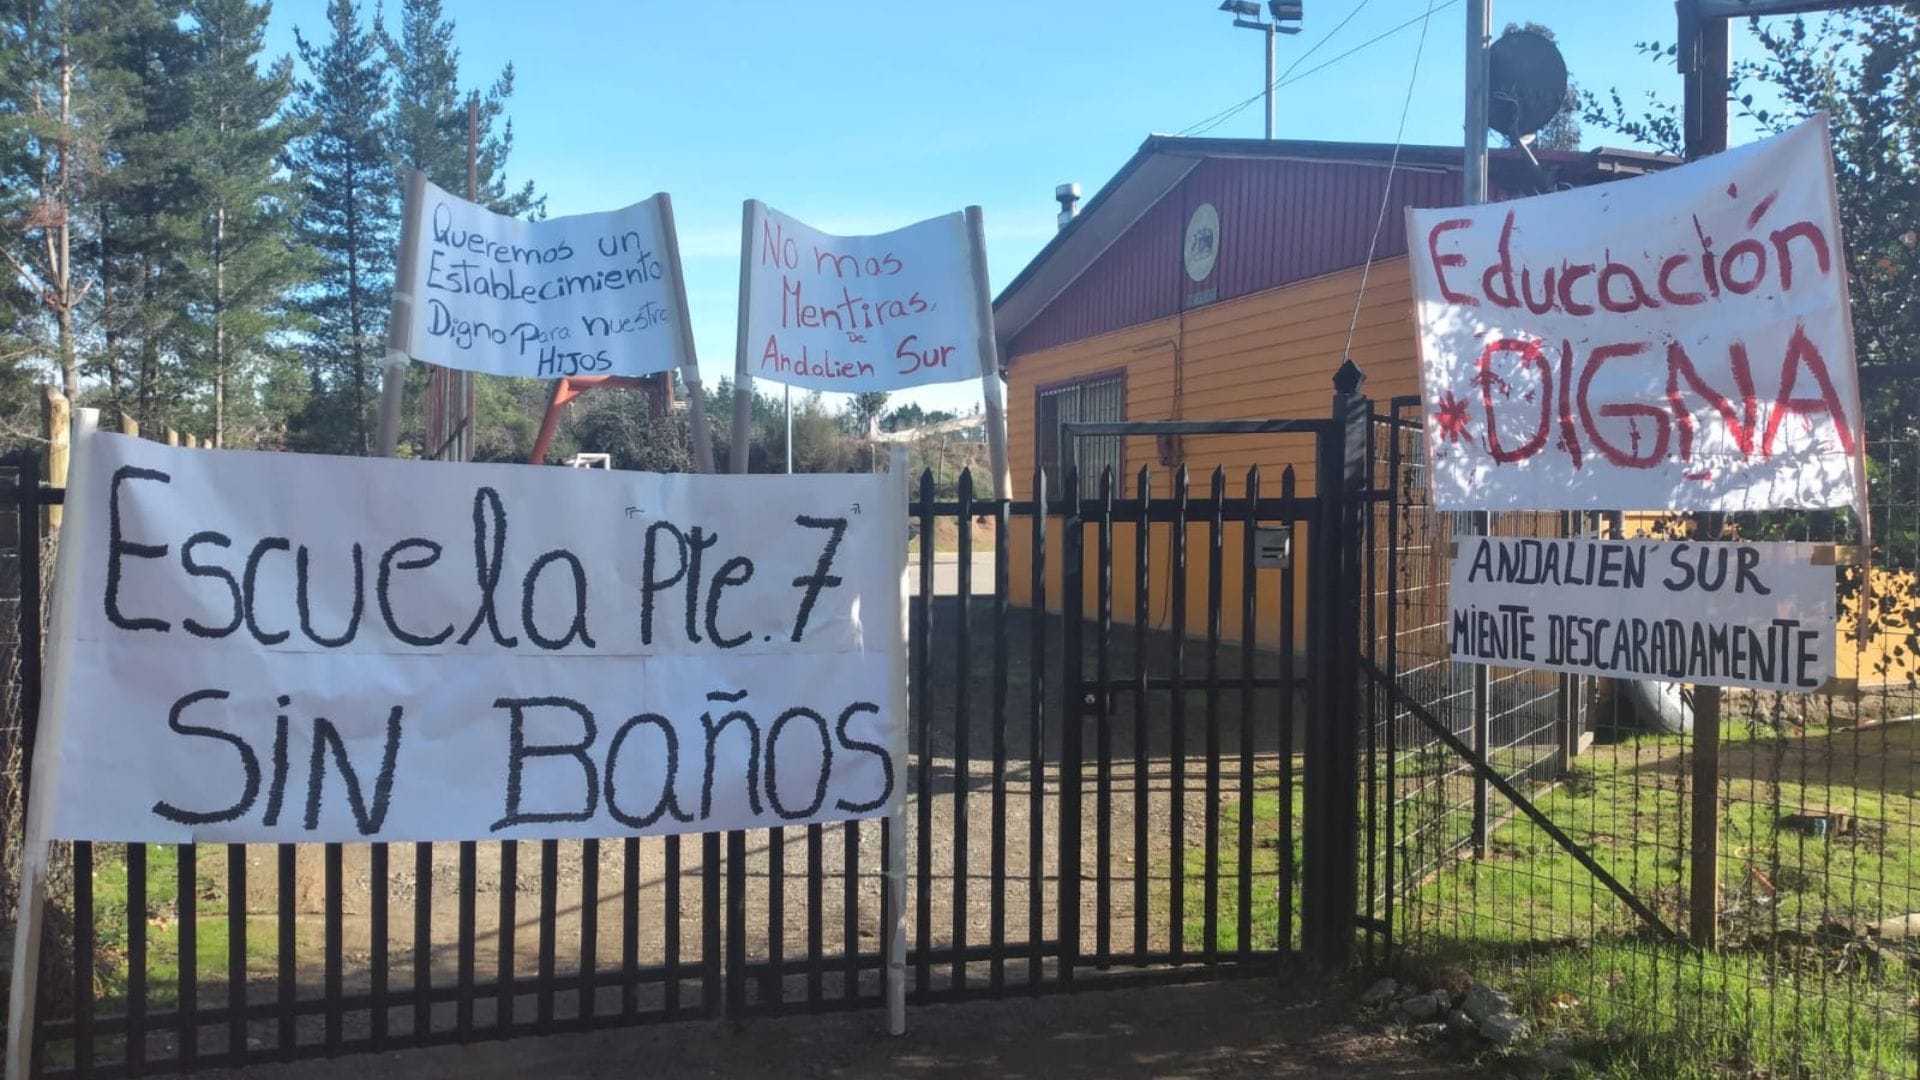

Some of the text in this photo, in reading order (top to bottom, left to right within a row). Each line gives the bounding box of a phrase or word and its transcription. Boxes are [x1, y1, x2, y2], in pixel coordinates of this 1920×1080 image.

[432, 202, 640, 265] Queremos un
[813, 246, 903, 278] mas
[1428, 182, 1831, 317] Educación
[426, 250, 663, 303] Establecimiento
[427, 298, 506, 350] Digno
[761, 334, 956, 378] Andalien Sur
[1475, 322, 1855, 470] DIGNA
[104, 464, 597, 650] Escuela
[1663, 544, 1771, 595] SUR
[1544, 614, 1819, 688] DESCARADAMENTE
[489, 689, 894, 833] Baños
